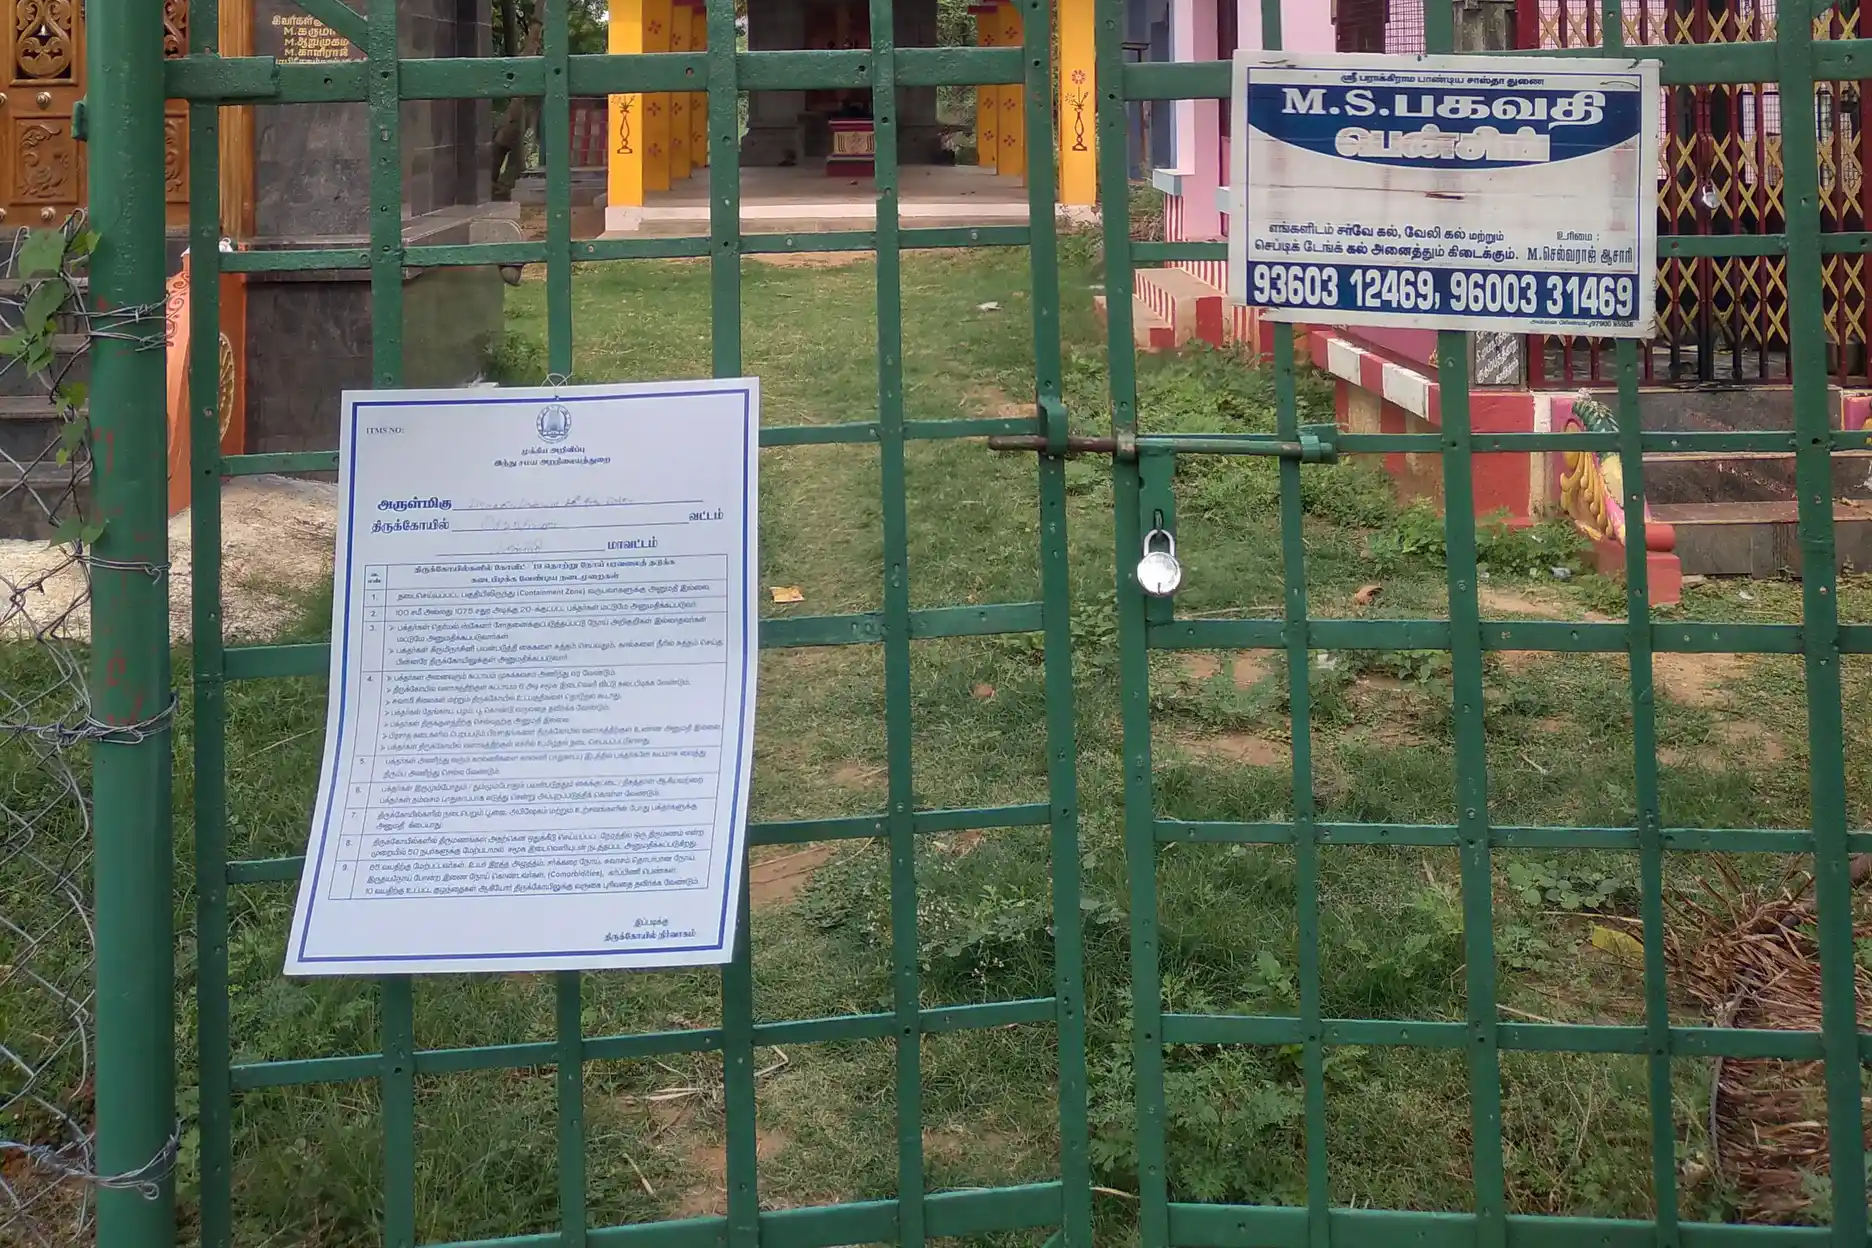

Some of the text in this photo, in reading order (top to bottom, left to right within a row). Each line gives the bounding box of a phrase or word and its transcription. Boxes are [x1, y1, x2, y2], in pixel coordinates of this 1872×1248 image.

[1417, 74, 1465, 86] பாண்டிய
[1466, 75, 1505, 87] சாஸ்தா
[1507, 77, 1545, 88] துணை
[1281, 87, 1606, 131] M.S.பகவதி
[1269, 221, 1335, 236] எங்களிடம்
[1337, 223, 1374, 237] சர்வே
[1404, 225, 1441, 240] வேலி
[1444, 226, 1466, 240] கல்
[1469, 229, 1505, 245] மற்றும்
[1255, 238, 1301, 255] செப்டிக்
[1303, 239, 1344, 254] டேங்க்
[1346, 241, 1369, 255] கல்
[1371, 242, 1446, 260] அனைத்தும்
[1448, 245, 1520, 263] கிடைக்கும்.
[1600, 247, 1633, 266] ஆசாரி
[1253, 264, 1633, 317] 93603 12469, 96003 31469
[366, 427, 388, 435] ITMS
[377, 497, 453, 513] அருள்மிகு
[370, 508, 724, 535] திருக்கோயில் வட்டம்
[607, 537, 659, 551] மாவட்டம்
